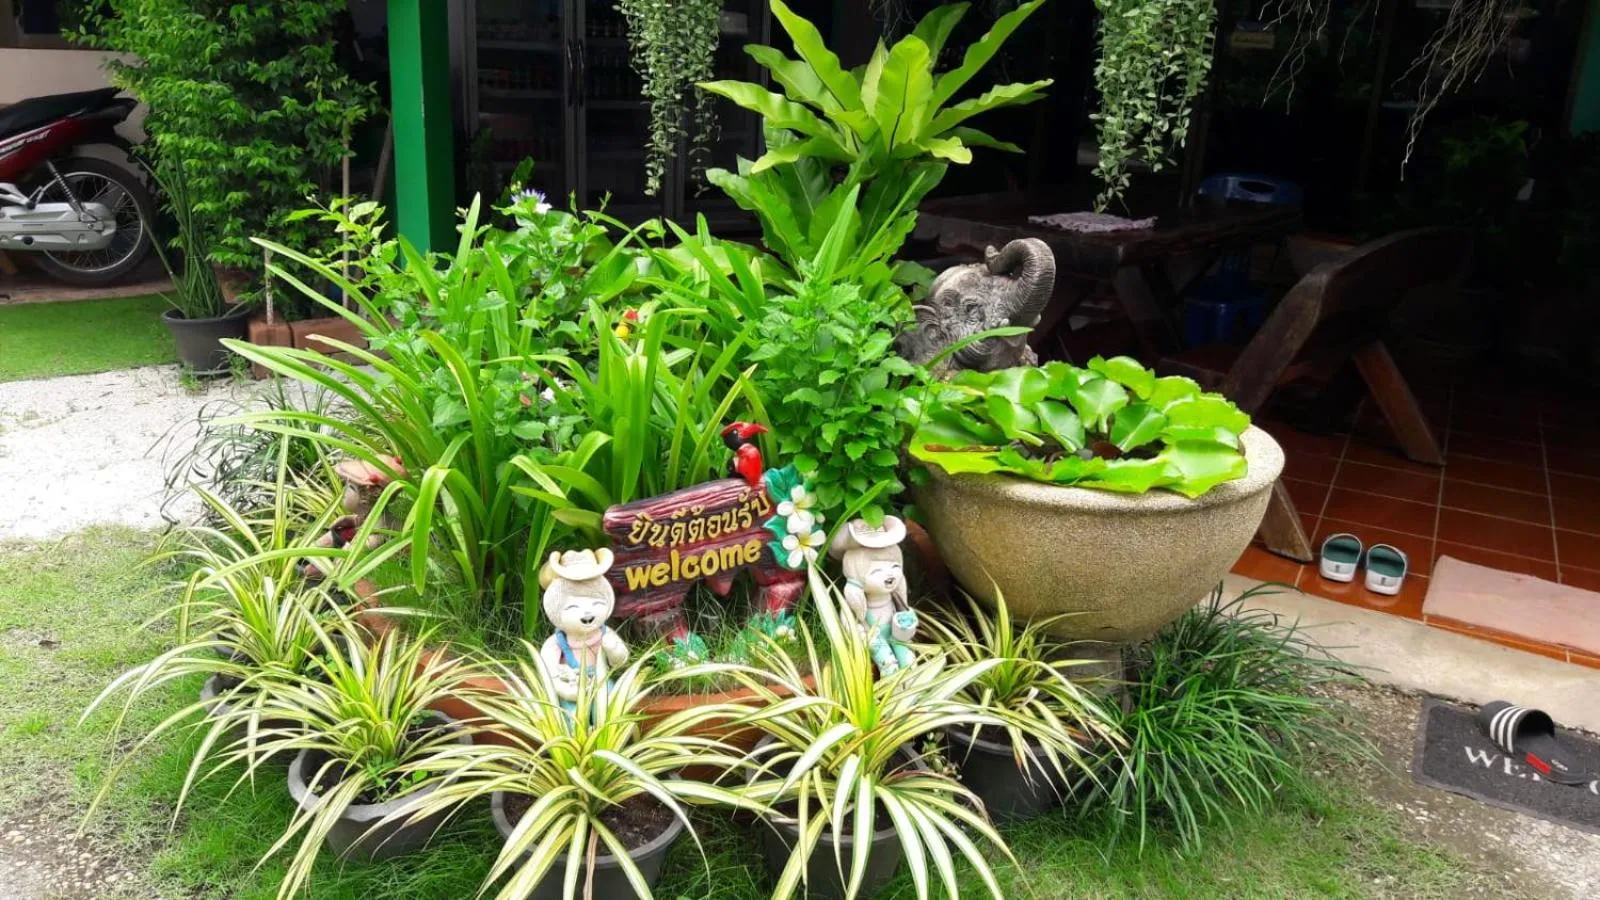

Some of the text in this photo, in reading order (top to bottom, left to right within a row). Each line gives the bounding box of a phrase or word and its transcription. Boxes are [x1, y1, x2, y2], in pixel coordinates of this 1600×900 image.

[628, 486, 770, 547] ยินดีต้อนรับ
[626, 539, 761, 591] welcome
